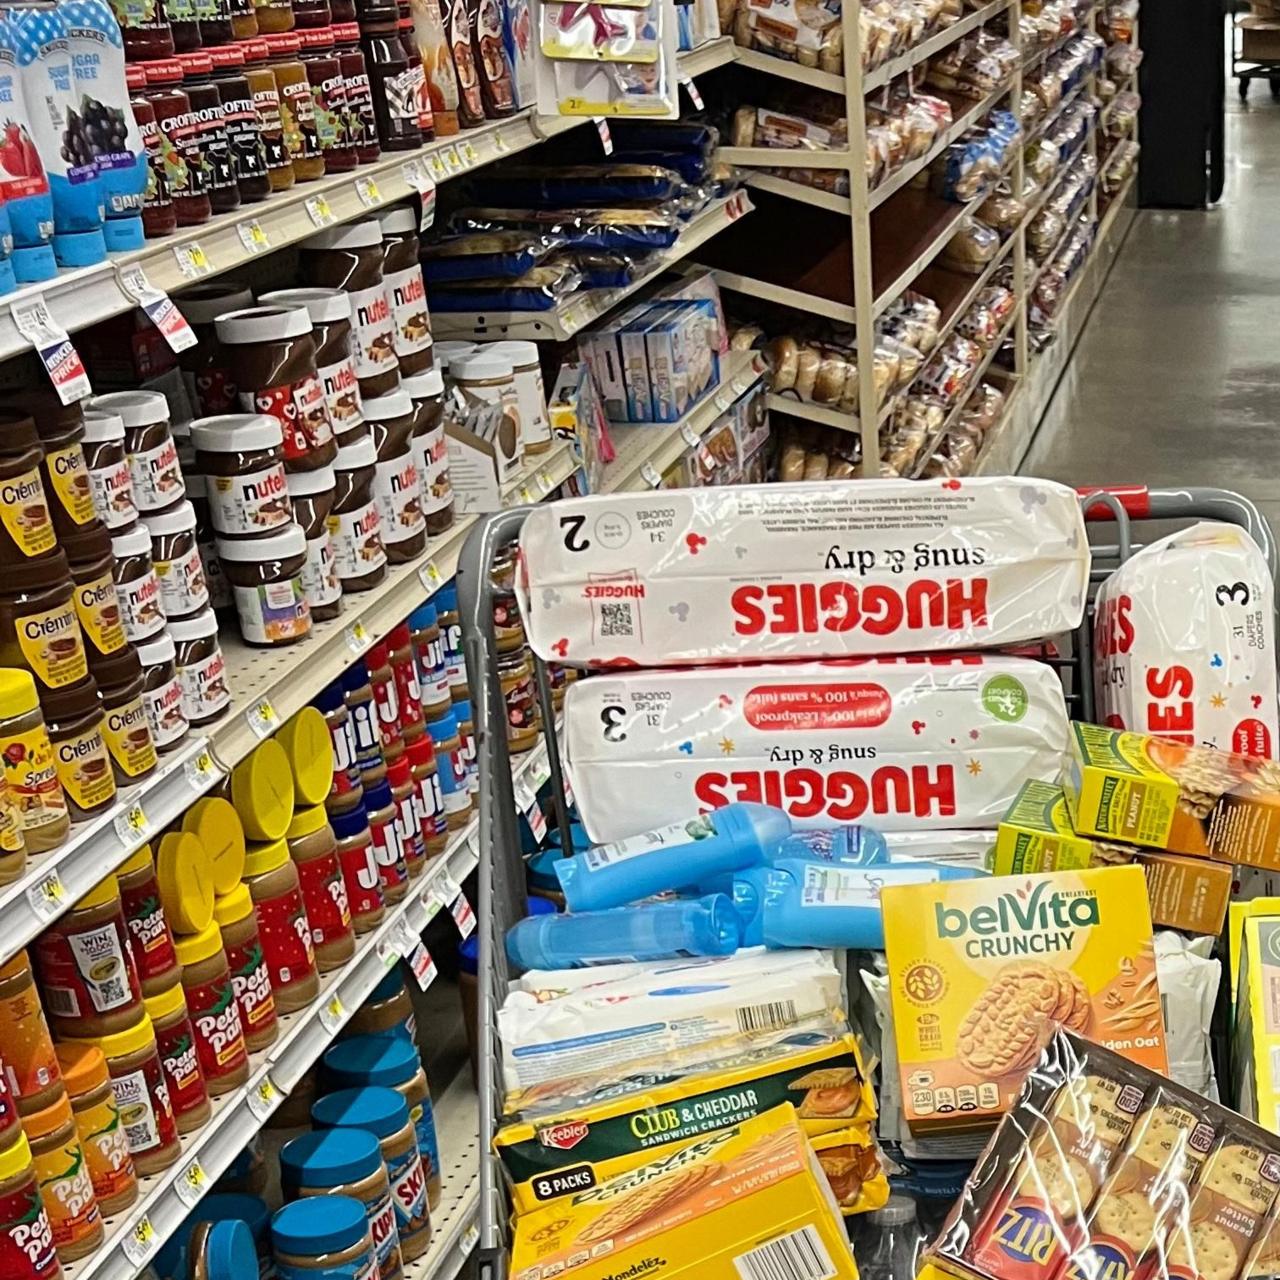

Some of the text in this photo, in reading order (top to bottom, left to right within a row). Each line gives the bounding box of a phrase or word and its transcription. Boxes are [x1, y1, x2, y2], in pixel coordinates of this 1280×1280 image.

[394, 279, 425, 306] nutel
[358, 293, 389, 327] nutel
[53, 356, 80, 384] PRICE
[243, 464, 285, 501] nutel
[391, 465, 416, 493] nute
[636, 508, 676, 521] COUCHES
[640, 518, 675, 532] DIAPERS
[559, 515, 591, 553] 2
[649, 529, 667, 546] 34
[824, 546, 986, 574] snug & dry
[584, 583, 645, 599] HUGGIES
[1215, 581, 1250, 608] 3
[731, 578, 989, 637] HUGGIES
[1232, 625, 1245, 639] 31
[1248, 614, 1257, 648] DIAPERS
[1256, 610, 1265, 650] COUCHES
[630, 691, 671, 700] COUCHES
[782, 690, 848, 703] 100 % sans
[354, 698, 382, 748] if
[600, 705, 627, 743] 3
[647, 715, 660, 727] 31
[753, 709, 856, 725] 100% Leakproof
[769, 743, 877, 765] snug & dry
[695, 763, 957, 820] HUGGIES
[400, 797, 422, 840] Ji
[1125, 791, 1141, 829] PEANUT
[934, 880, 1101, 939] belVita
[81, 932, 108, 947] WIN
[138, 921, 165, 944] Pan
[966, 931, 1076, 959] CRUNCHY
[240, 979, 273, 1013] Pan
[209, 1021, 242, 1054] Pan
[1135, 1036, 1160, 1049] Oat
[681, 1089, 759, 1123] & CHEDDAR
[915, 1091, 932, 1103] 230
[540, 1120, 588, 1147] Keebler
[640, 1110, 758, 1149] SANDWICH CRACKERS
[538, 1170, 592, 1197] 8 PACKS
[66, 1191, 94, 1219] Pa
[1220, 1202, 1258, 1228] butter
[993, 1206, 1058, 1267] RITZ
[1212, 1212, 1257, 1240] peanut
[23, 1226, 53, 1264] Pa
